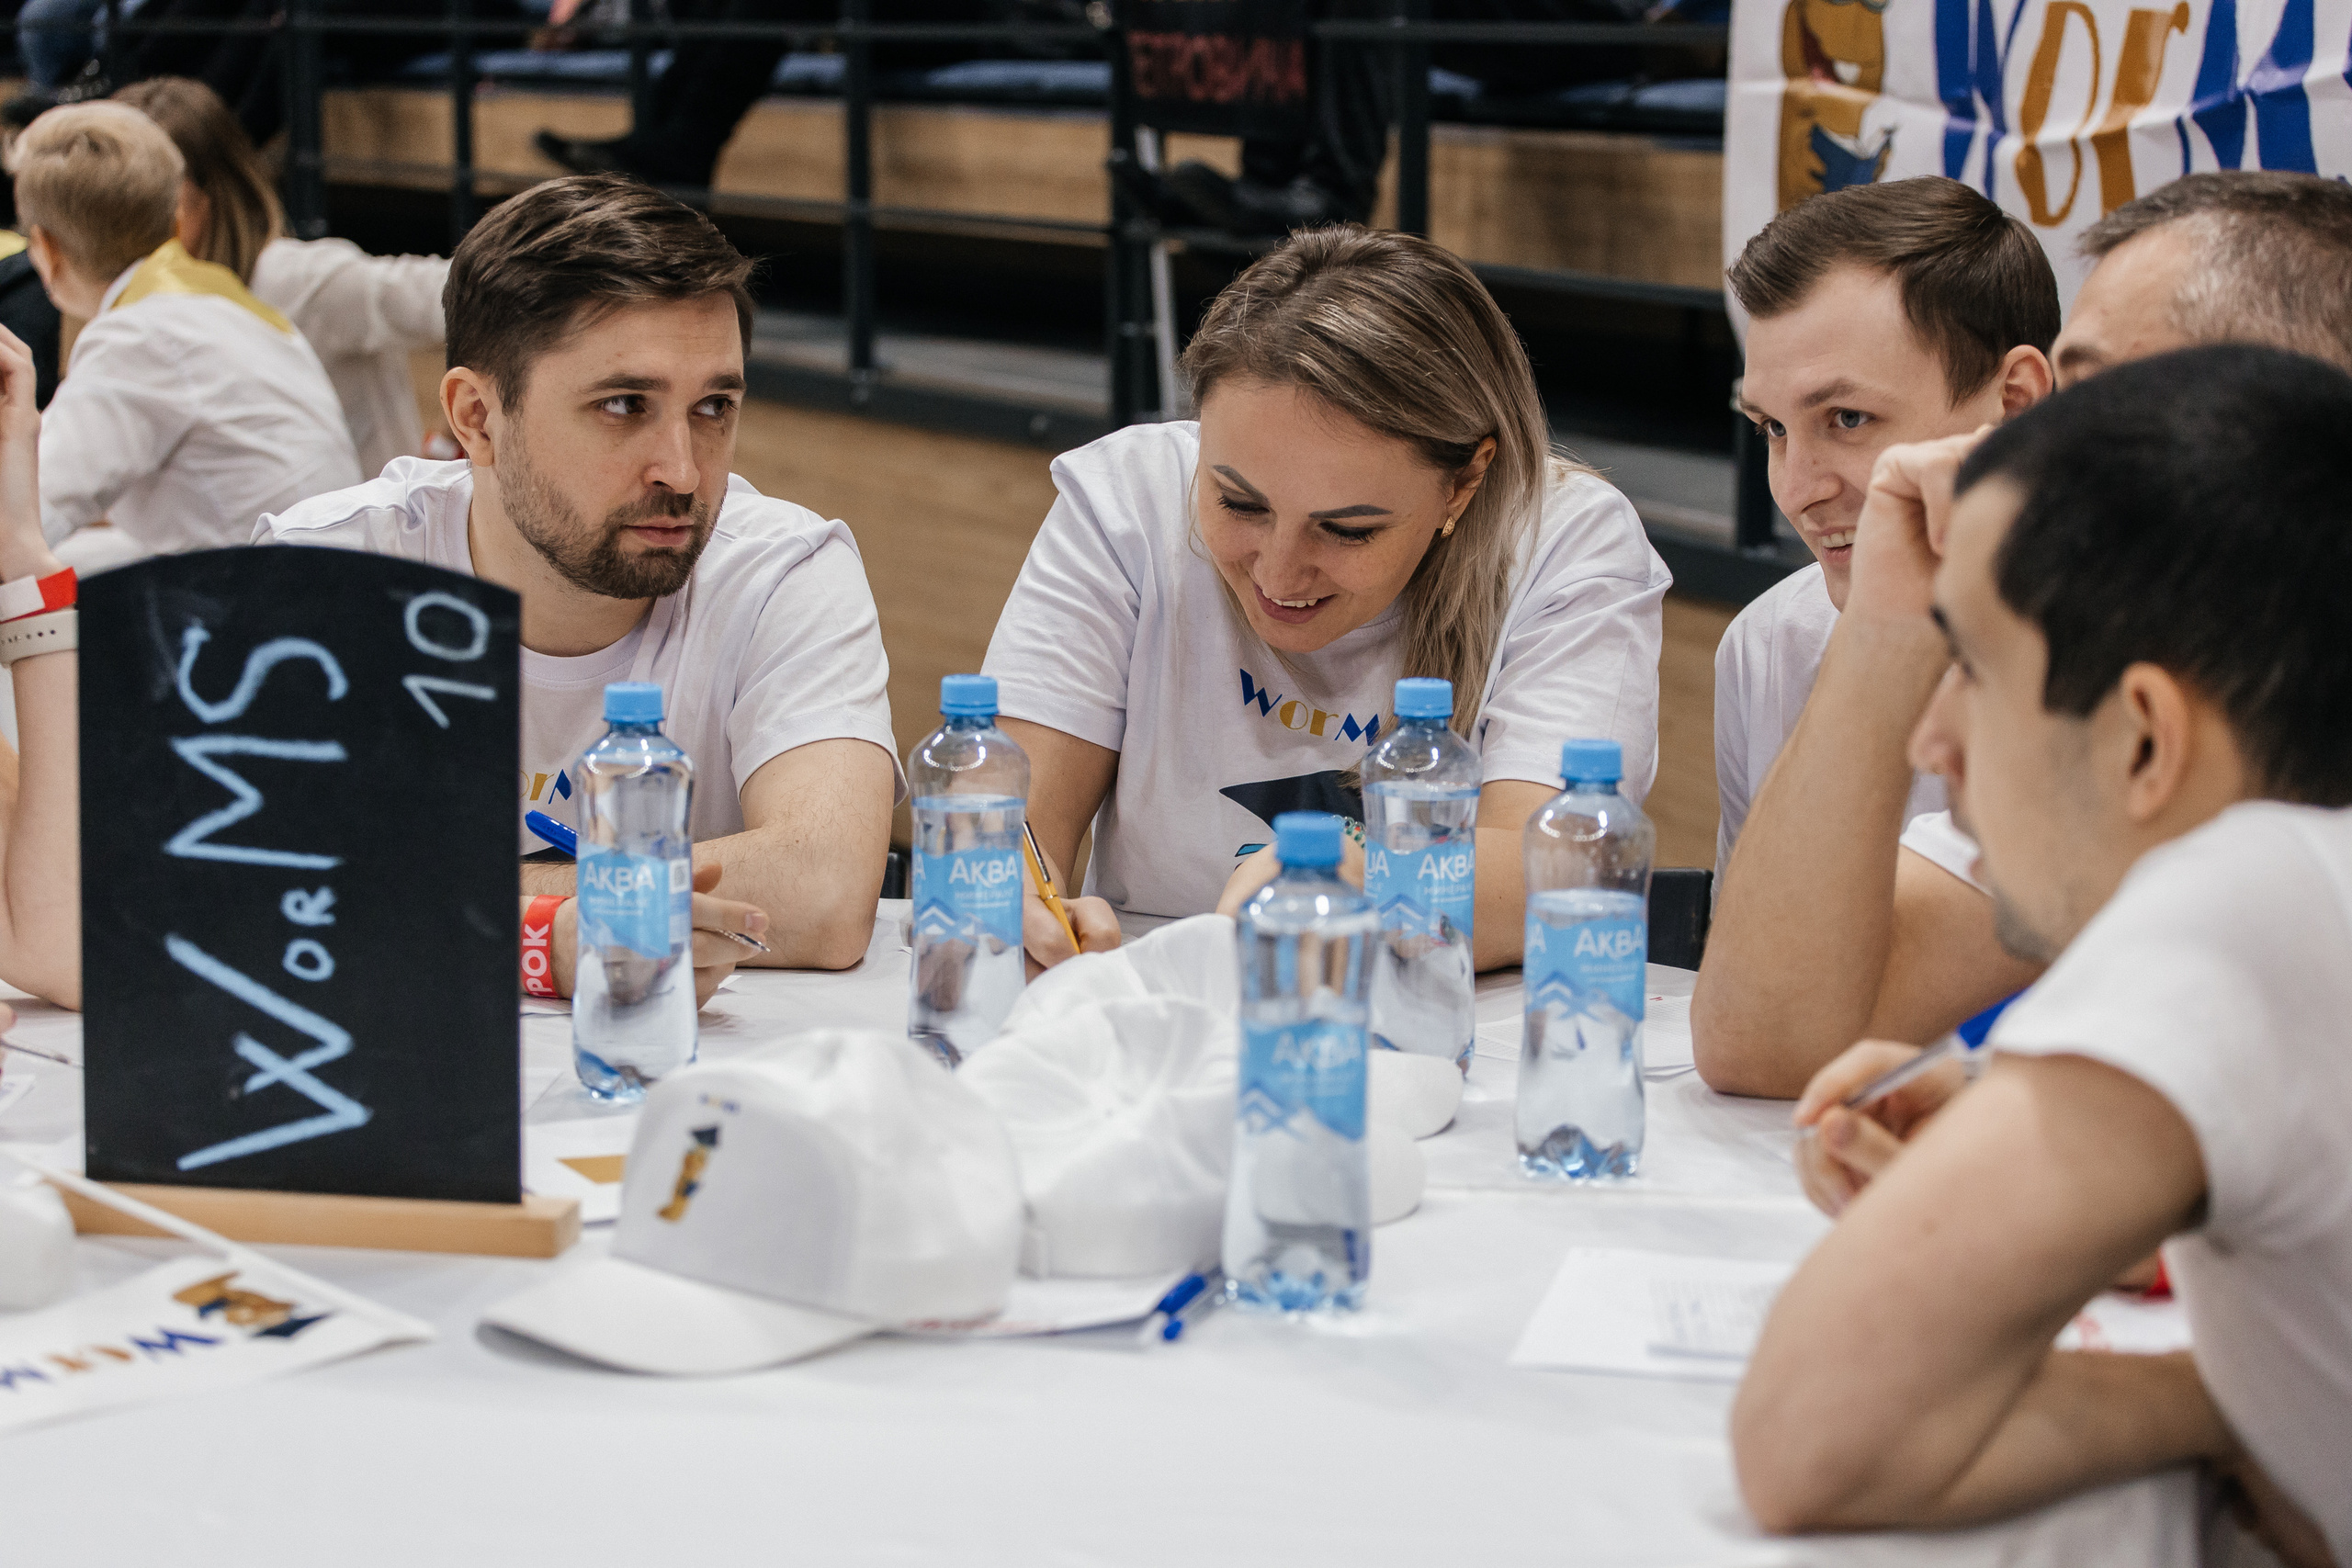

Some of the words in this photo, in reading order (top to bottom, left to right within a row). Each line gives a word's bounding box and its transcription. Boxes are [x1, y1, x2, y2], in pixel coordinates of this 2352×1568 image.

[1933, 0, 2352, 228] WorM
[404, 591, 496, 728] 10
[582, 860, 657, 897] АКВА
[949, 852, 1019, 888] АКВА
[521, 922, 558, 998] РОК
